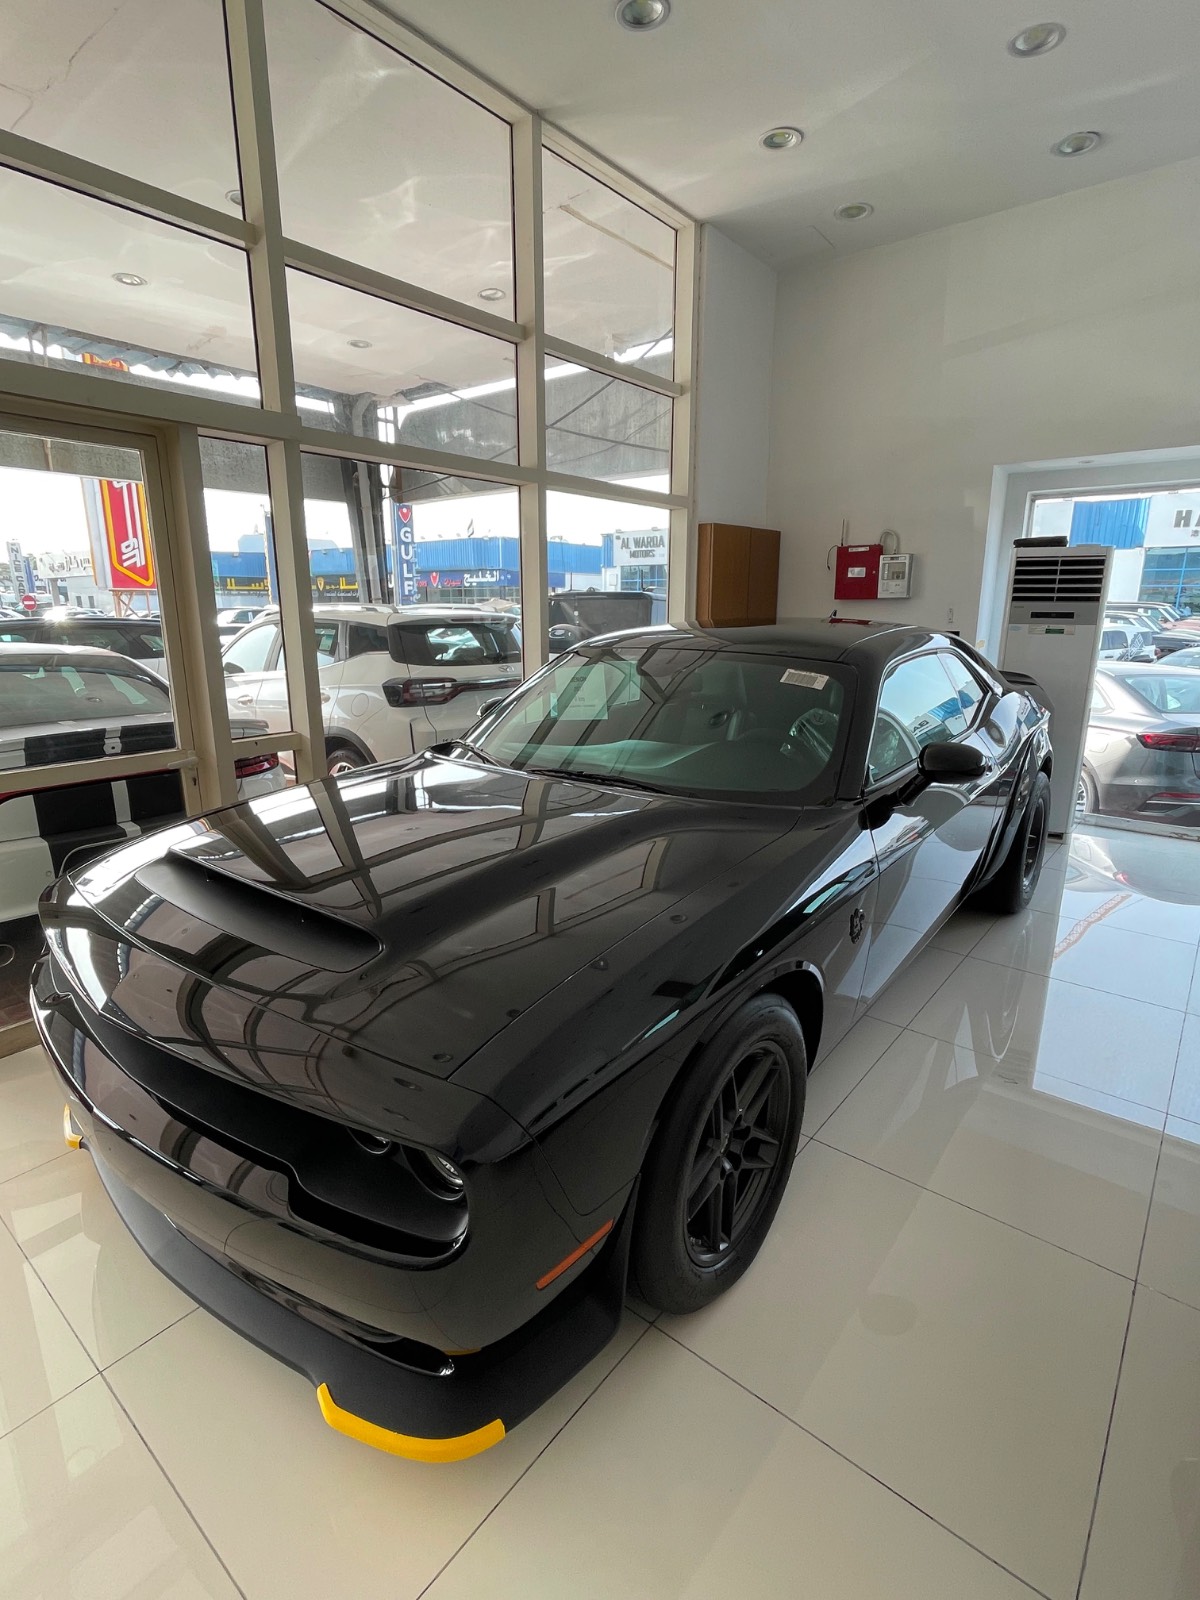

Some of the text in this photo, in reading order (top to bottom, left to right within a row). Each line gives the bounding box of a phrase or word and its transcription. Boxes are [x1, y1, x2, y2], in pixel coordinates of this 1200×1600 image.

[620, 537, 631, 550] AL
[10, 547, 22, 573] NICE
[400, 527, 414, 595] GULF
[463, 570, 500, 587] الخليج
